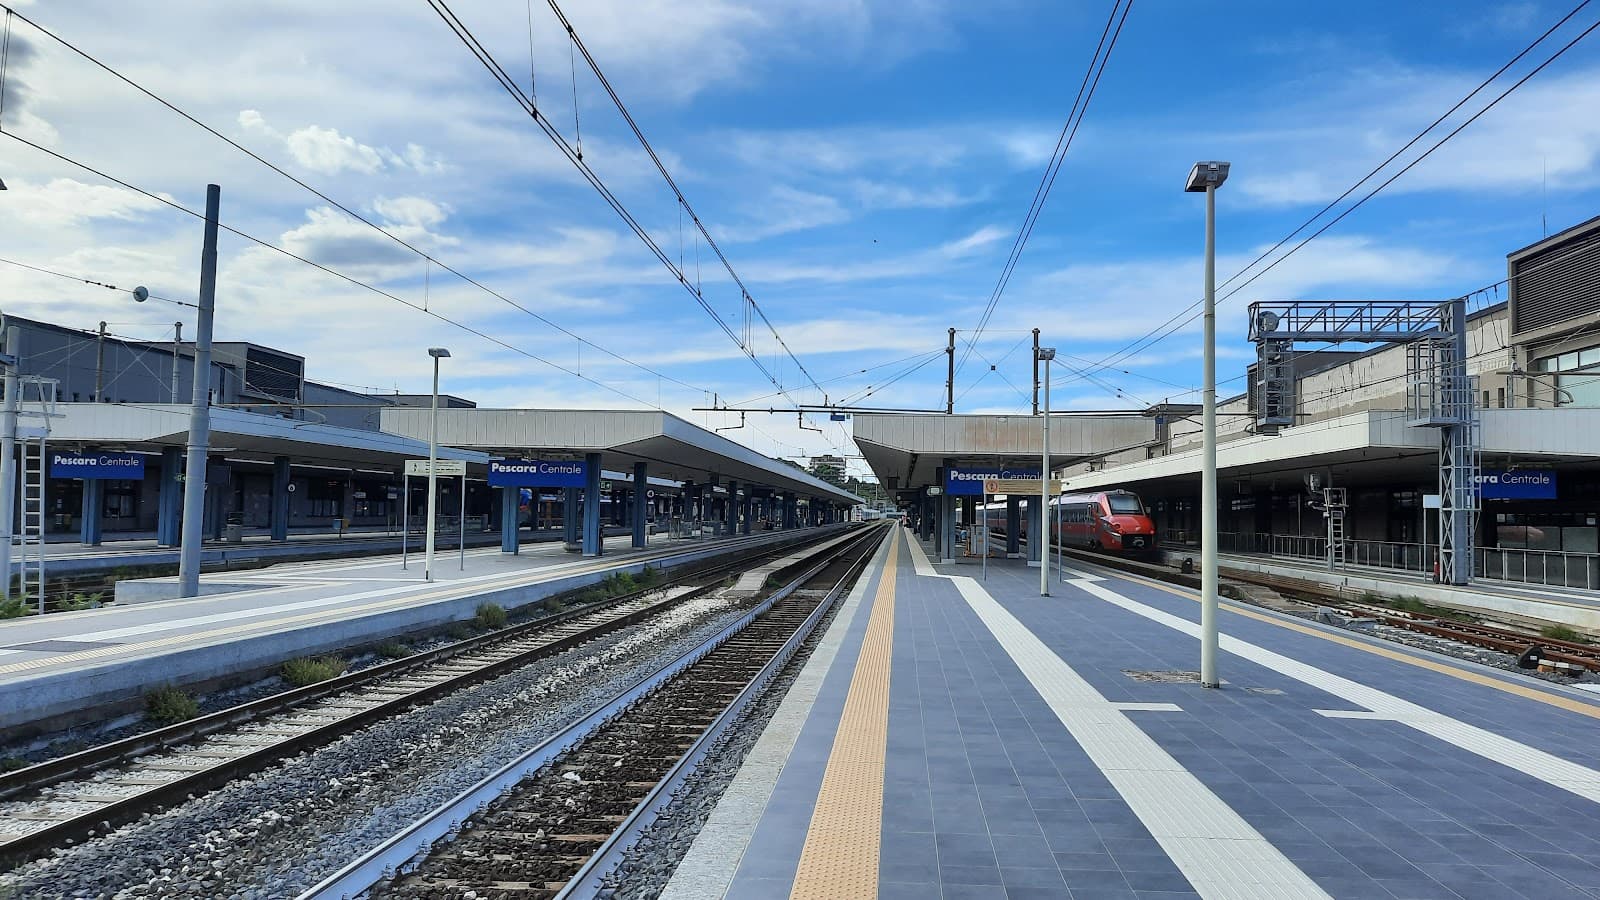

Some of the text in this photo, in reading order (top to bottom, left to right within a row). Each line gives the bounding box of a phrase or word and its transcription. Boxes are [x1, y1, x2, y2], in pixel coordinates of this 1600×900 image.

[54, 455, 139, 466] Pescara Centrale
[491, 462, 582, 474] Pescara Centrale
[950, 470, 1043, 480] Pescara Central
[1501, 472, 1550, 484] Centrale
